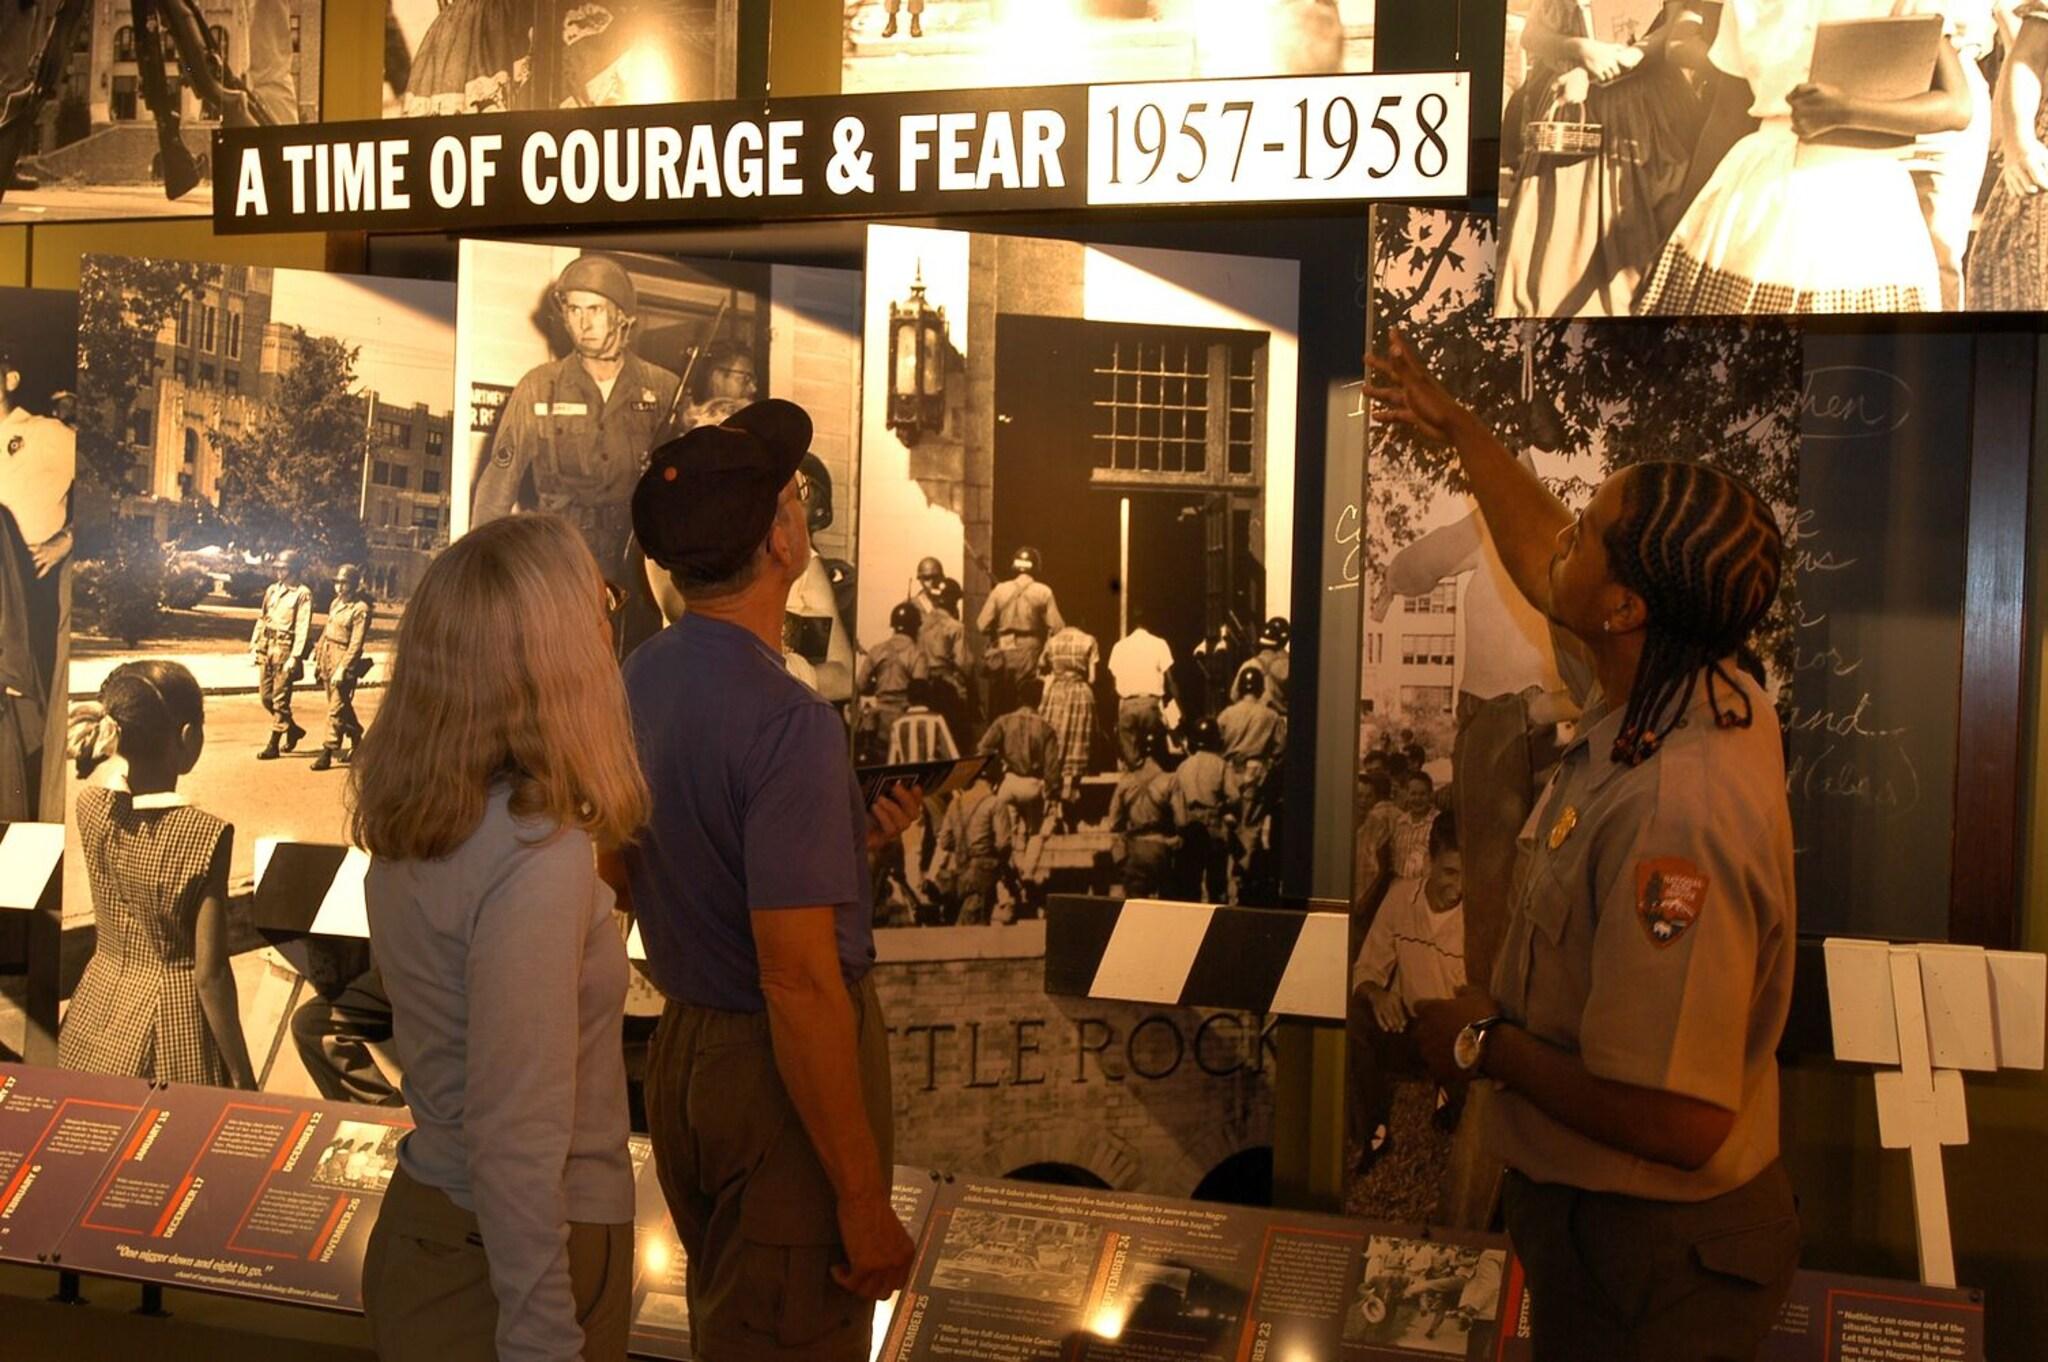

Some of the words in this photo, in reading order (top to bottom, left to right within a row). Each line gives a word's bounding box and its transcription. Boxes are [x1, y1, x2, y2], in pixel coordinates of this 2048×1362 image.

[1108, 93, 1448, 184] 1957-1958
[235, 148, 268, 216] A
[282, 139, 410, 213] TIME
[429, 134, 502, 208] OF
[521, 120, 804, 206] COURAGE
[825, 115, 870, 195] &
[900, 110, 1066, 191] FEAR
[282, 1121, 317, 1173] DECEMBER
[310, 1112, 324, 1125] 12
[1, 1172, 36, 1219] FEBRUARY
[163, 1189, 198, 1238] DECEMBER
[192, 1176, 205, 1189] 17
[319, 1209, 354, 1263] NOVEMBER
[168, 1253, 193, 1266] down
[193, 1258, 214, 1269] and
[213, 1260, 238, 1274] eight
[238, 1263, 248, 1274] to
[916, 1294, 929, 1309] 25
[1258, 1322, 1271, 1337] 23
[1842, 1323, 1882, 1334] situation
[1884, 1327, 1900, 1336] the
[1902, 1330, 1919, 1340] way
[1932, 1333, 1941, 1342] is
[1880, 1316, 1896, 1325] can
[1898, 1319, 1921, 1328] come
[1922, 1321, 1938, 1330] out
[1939, 1322, 1949, 1331] of
[1950, 1323, 1965, 1333] the
[1842, 1332, 1856, 1342] Let
[1857, 1333, 1872, 1343] the
[1873, 1336, 1891, 1346] kids
[1892, 1338, 1922, 1350] handle
[1923, 1342, 1938, 1352] the
[1870, 1346, 1884, 1356] the
[1885, 1348, 1921, 1361] Negroes
